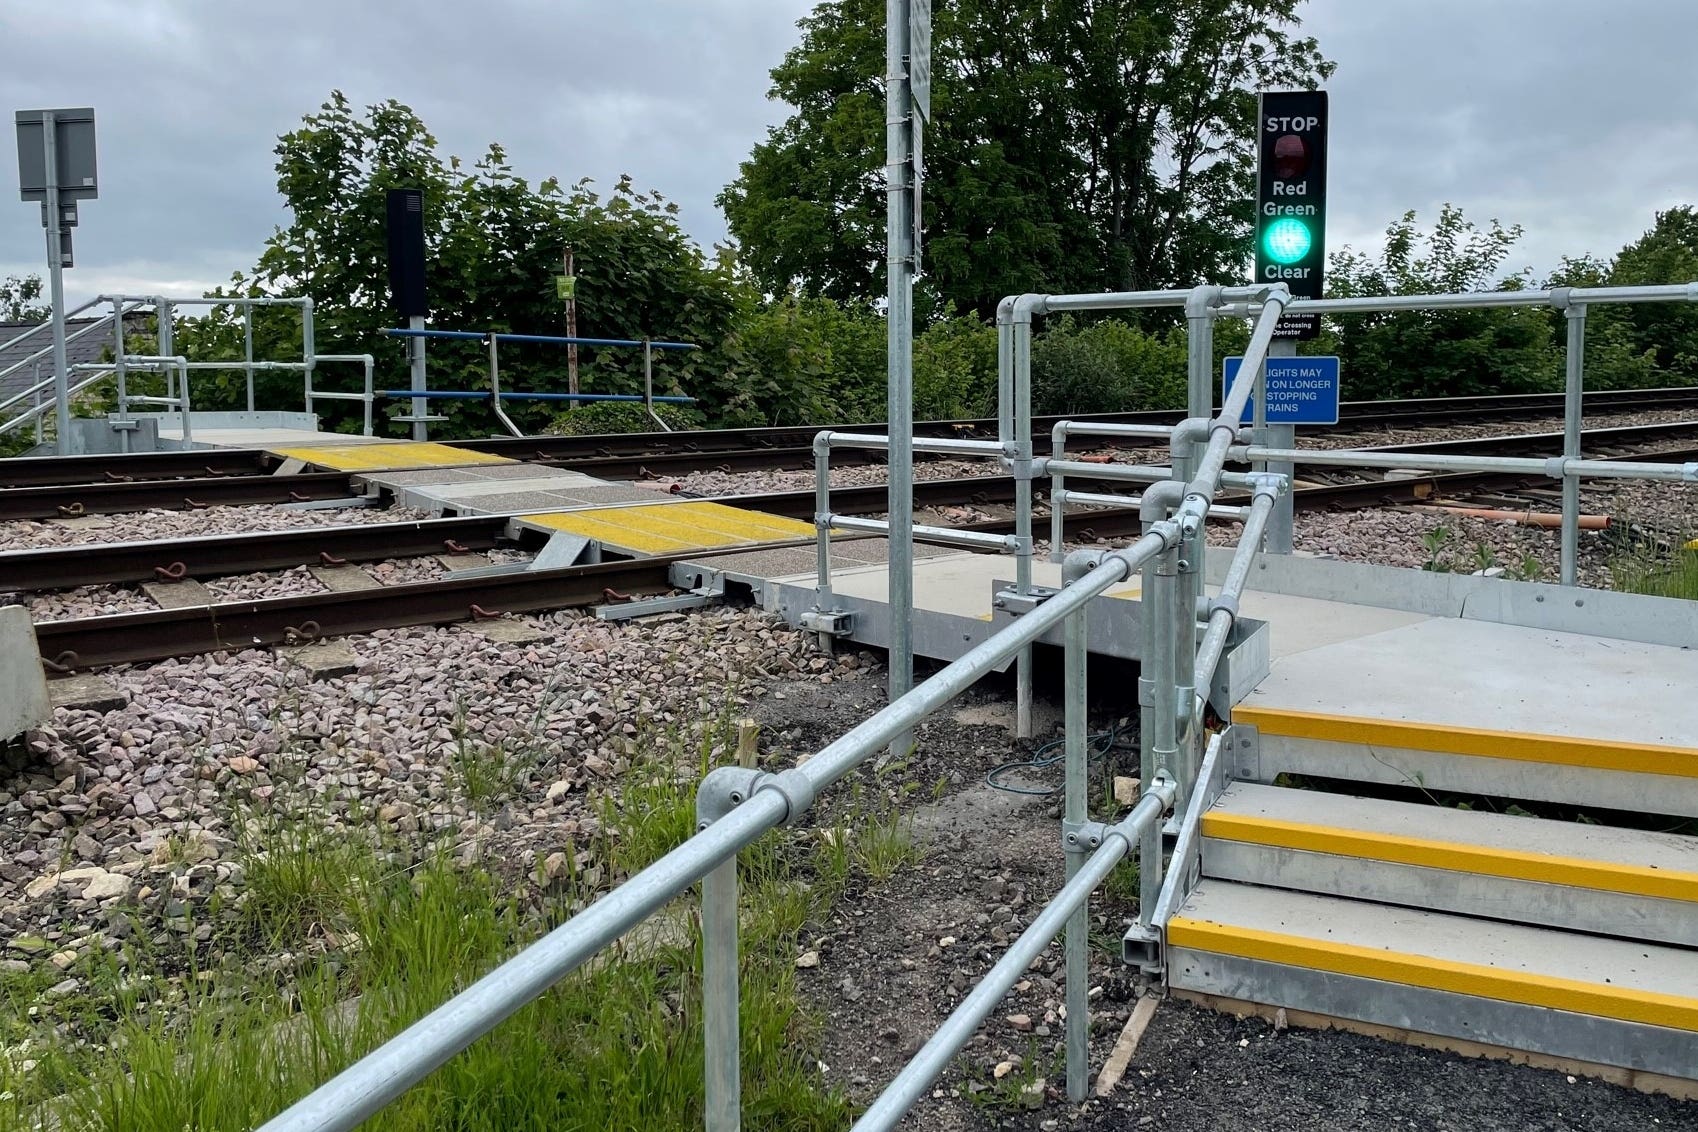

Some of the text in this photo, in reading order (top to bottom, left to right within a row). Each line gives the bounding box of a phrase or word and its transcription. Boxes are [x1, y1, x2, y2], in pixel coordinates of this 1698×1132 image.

[1266, 117, 1318, 132] STOP
[1273, 181, 1307, 195] Red
[1263, 202, 1316, 216] Green
[1264, 265, 1311, 279] Clear
[1300, 368, 1322, 377] MAY
[1272, 380, 1287, 389] ON
[1289, 380, 1331, 389] LONGER
[1266, 392, 1317, 400] STOPPING
